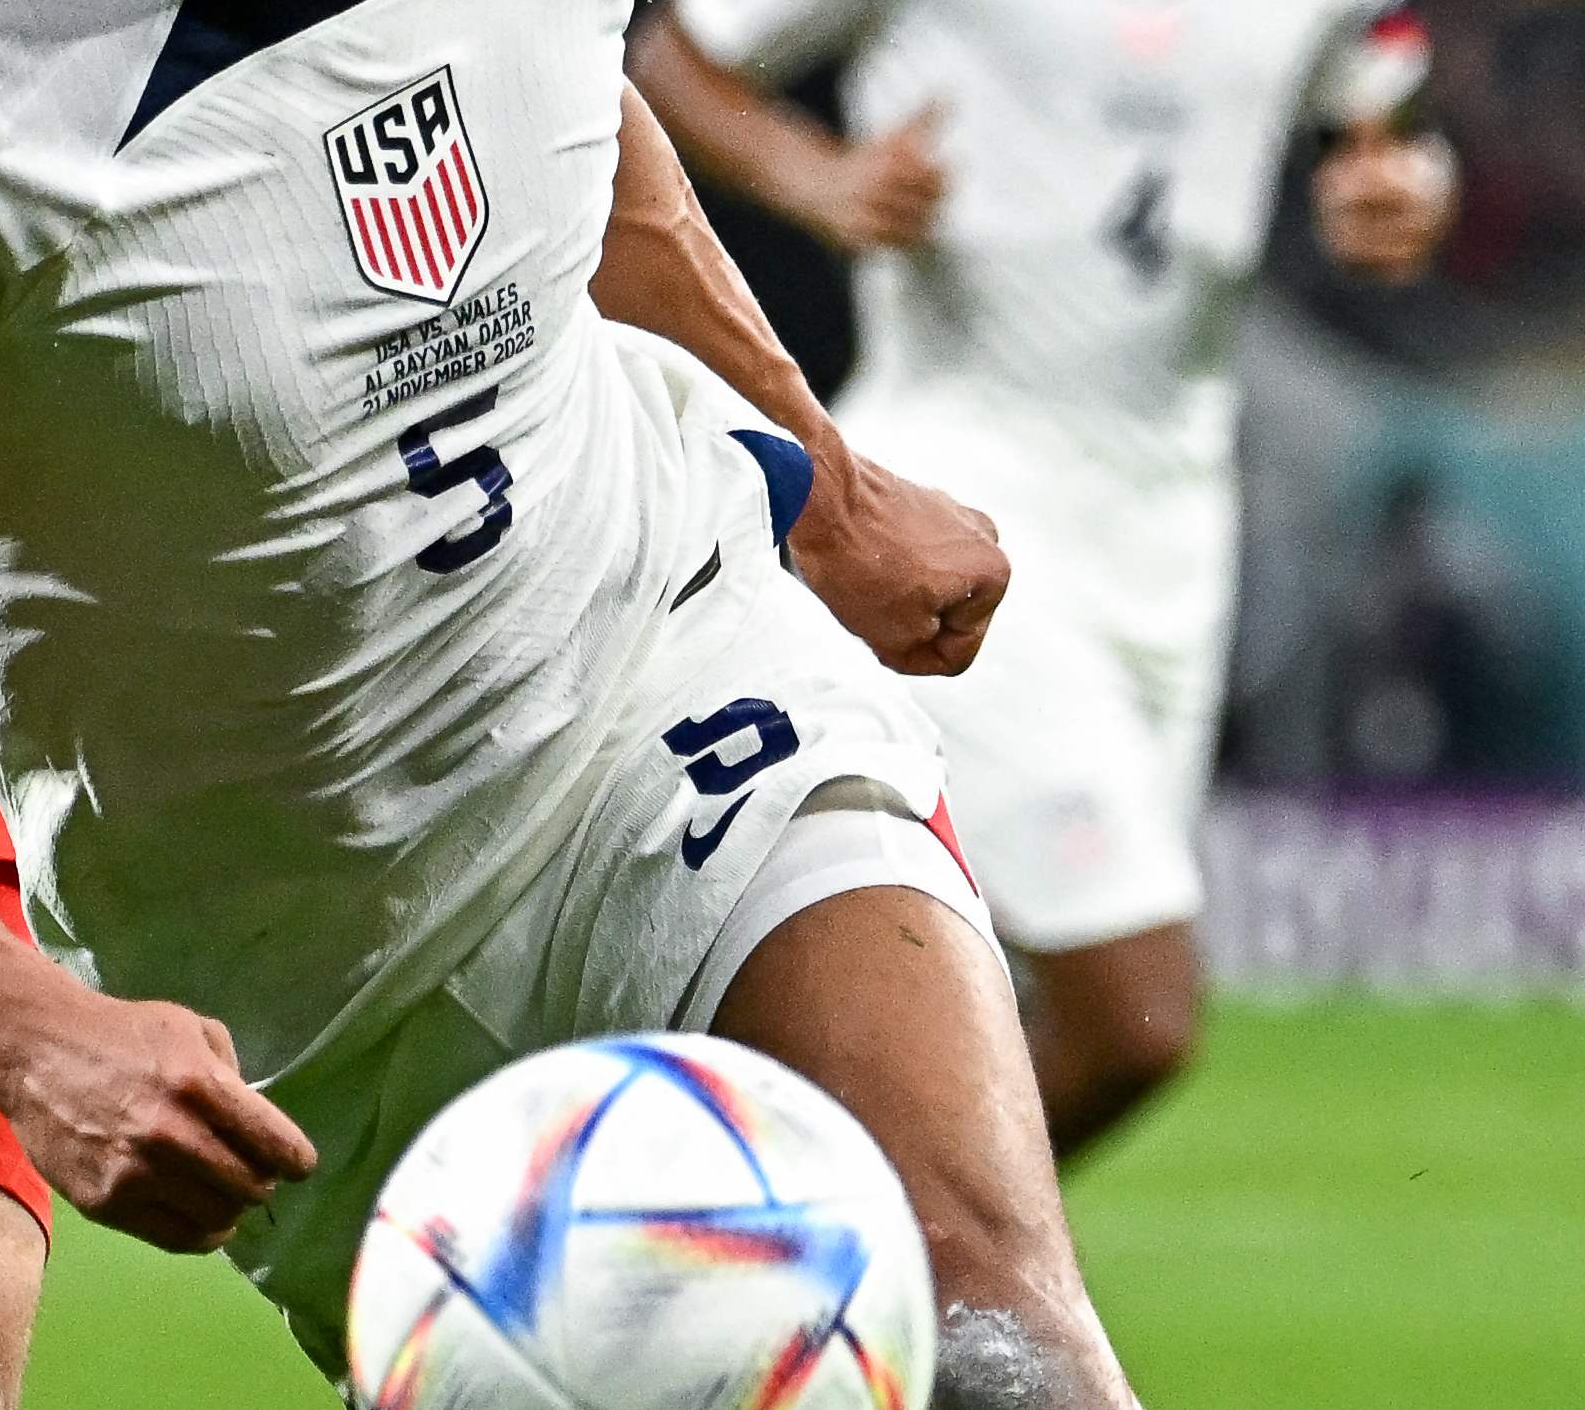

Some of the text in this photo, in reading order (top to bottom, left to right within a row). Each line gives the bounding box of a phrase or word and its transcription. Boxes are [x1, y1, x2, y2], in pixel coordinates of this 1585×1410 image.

[335, 81, 450, 185] USA
[375, 329, 411, 364] USA
[453, 282, 519, 328] WALES
[363, 325, 535, 420] 21 NOVEMBER 2022
[365, 370, 387, 393] AL
[397, 383, 513, 575] 5
[661, 698, 800, 795] 5
